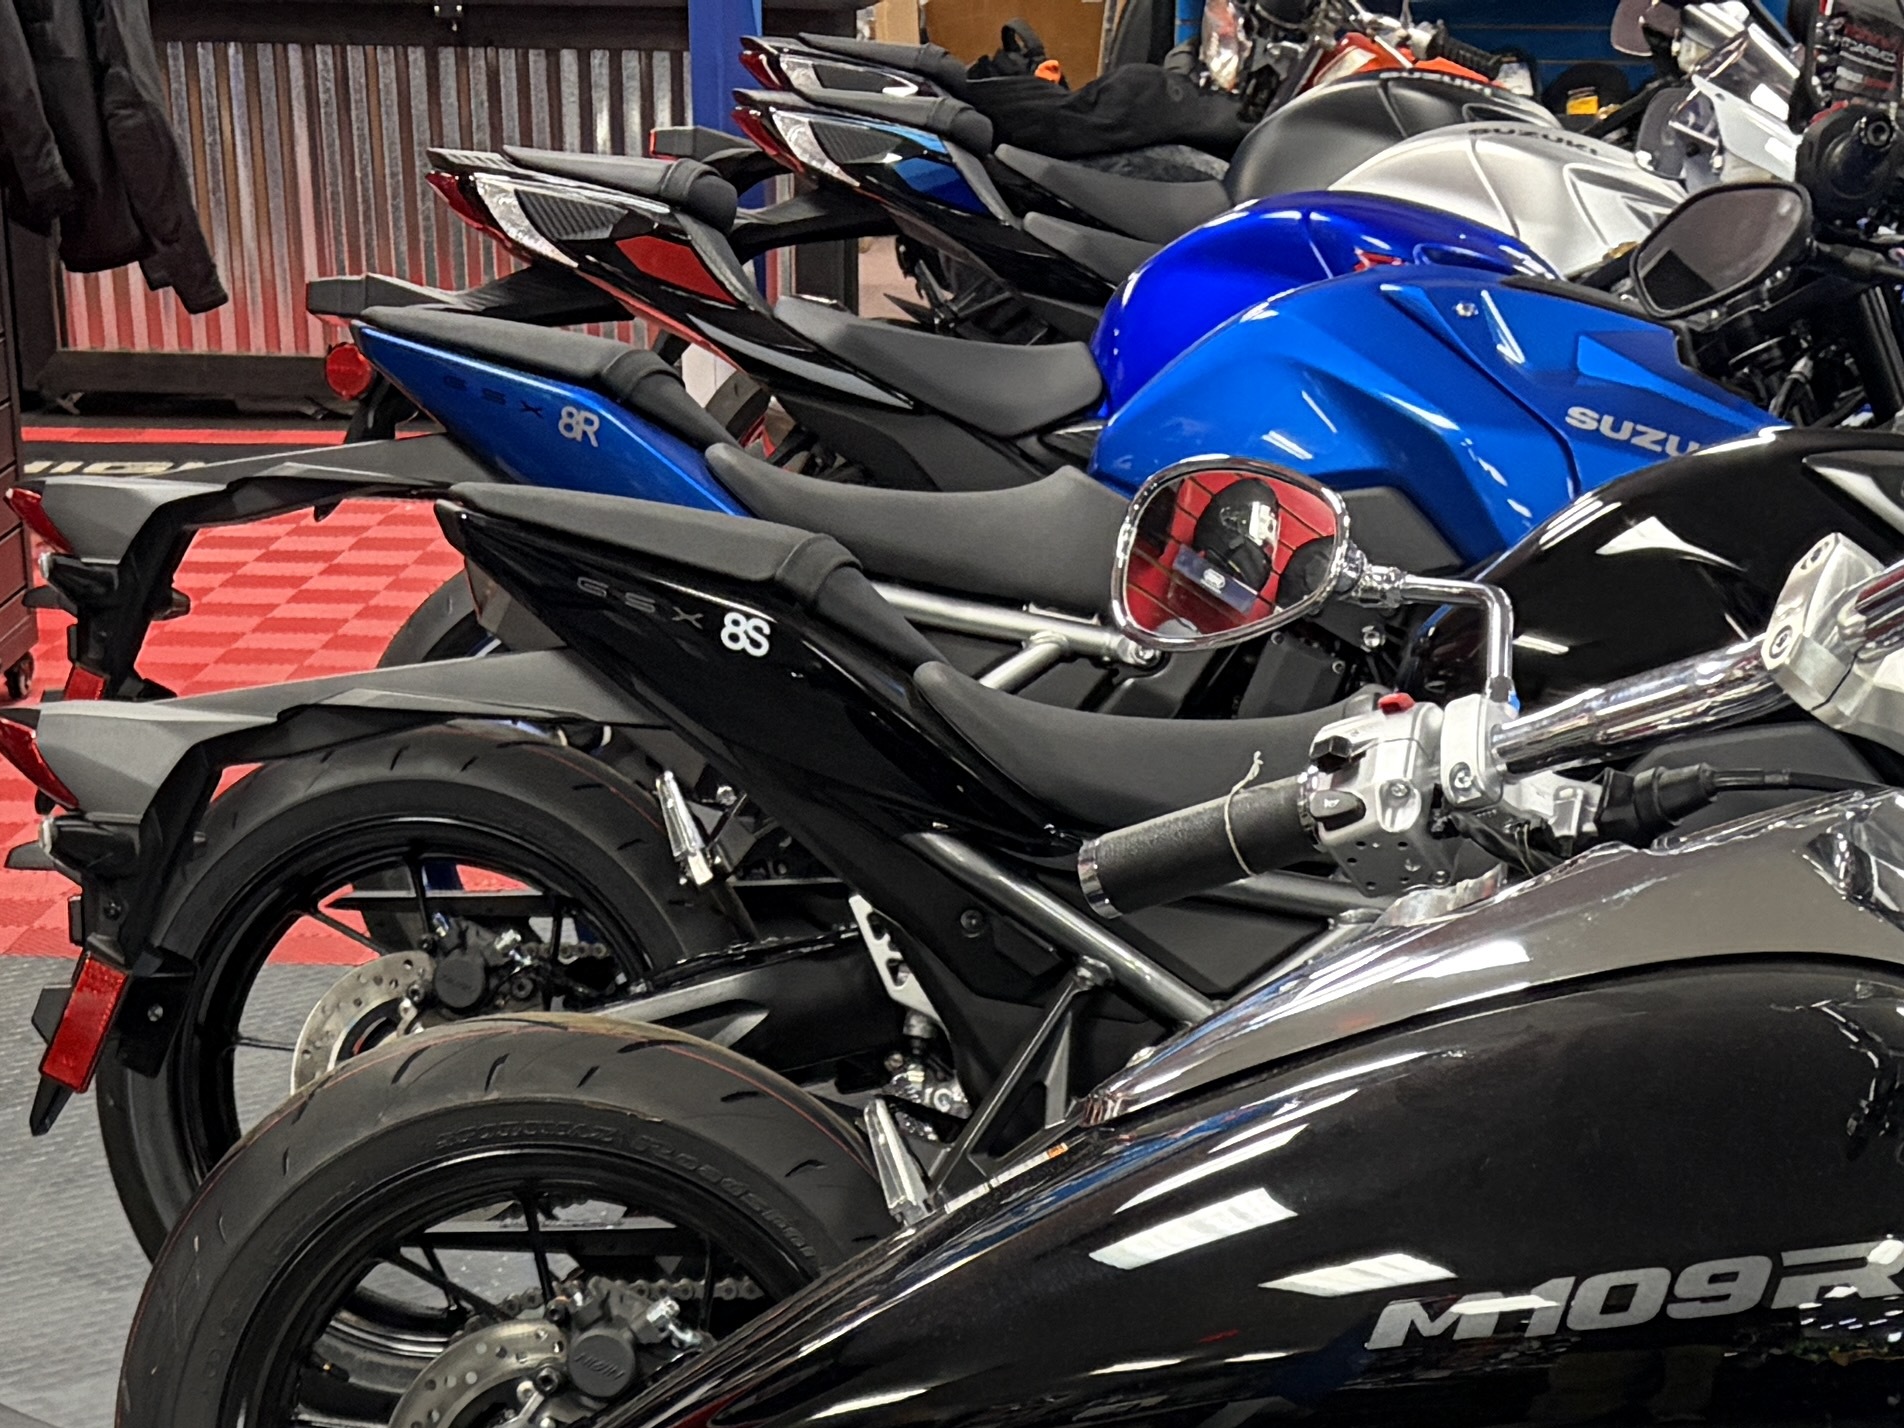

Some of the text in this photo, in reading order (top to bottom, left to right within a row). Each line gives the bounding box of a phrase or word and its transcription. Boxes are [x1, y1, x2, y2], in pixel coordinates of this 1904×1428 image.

[558, 406, 600, 448] 8R
[1565, 405, 1700, 457] SUZU
[720, 611, 771, 658] 8S
